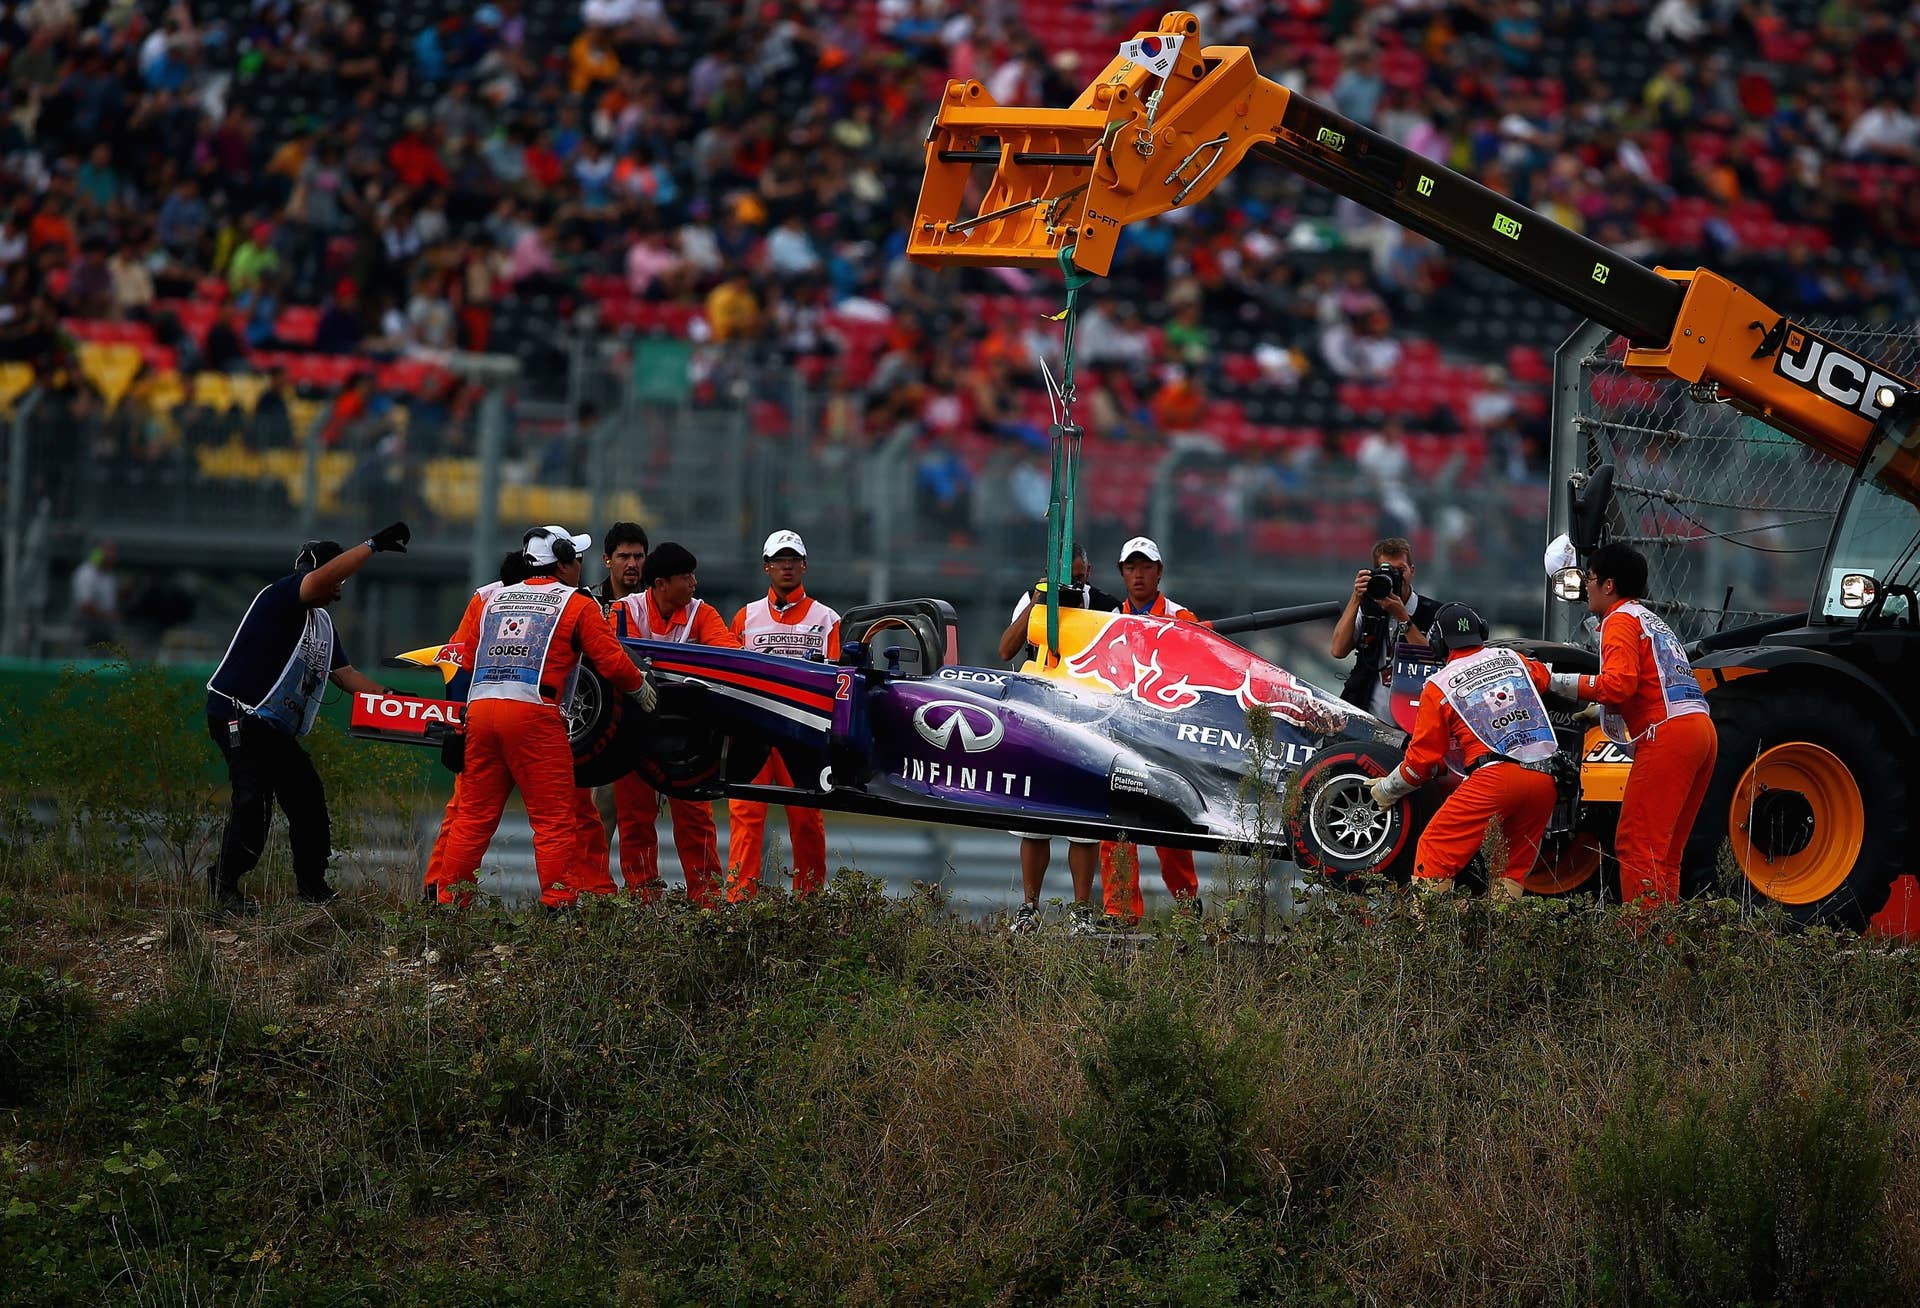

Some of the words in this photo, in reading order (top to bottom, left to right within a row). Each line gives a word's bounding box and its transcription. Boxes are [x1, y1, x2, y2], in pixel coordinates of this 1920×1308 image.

[1594, 266, 1604, 281] 2
[806, 636, 820, 646] 2013
[488, 645, 529, 657] COURSE
[938, 669, 1009, 686] GEOX
[835, 674, 850, 701] 2
[359, 692, 462, 724] TOTAL
[1586, 743, 1635, 762] JC
[902, 757, 1032, 797] INFINITI
[1114, 766, 1149, 779] SIEMENS
[1113, 783, 1148, 795] Computing
[1114, 776, 1144, 787] Platform
